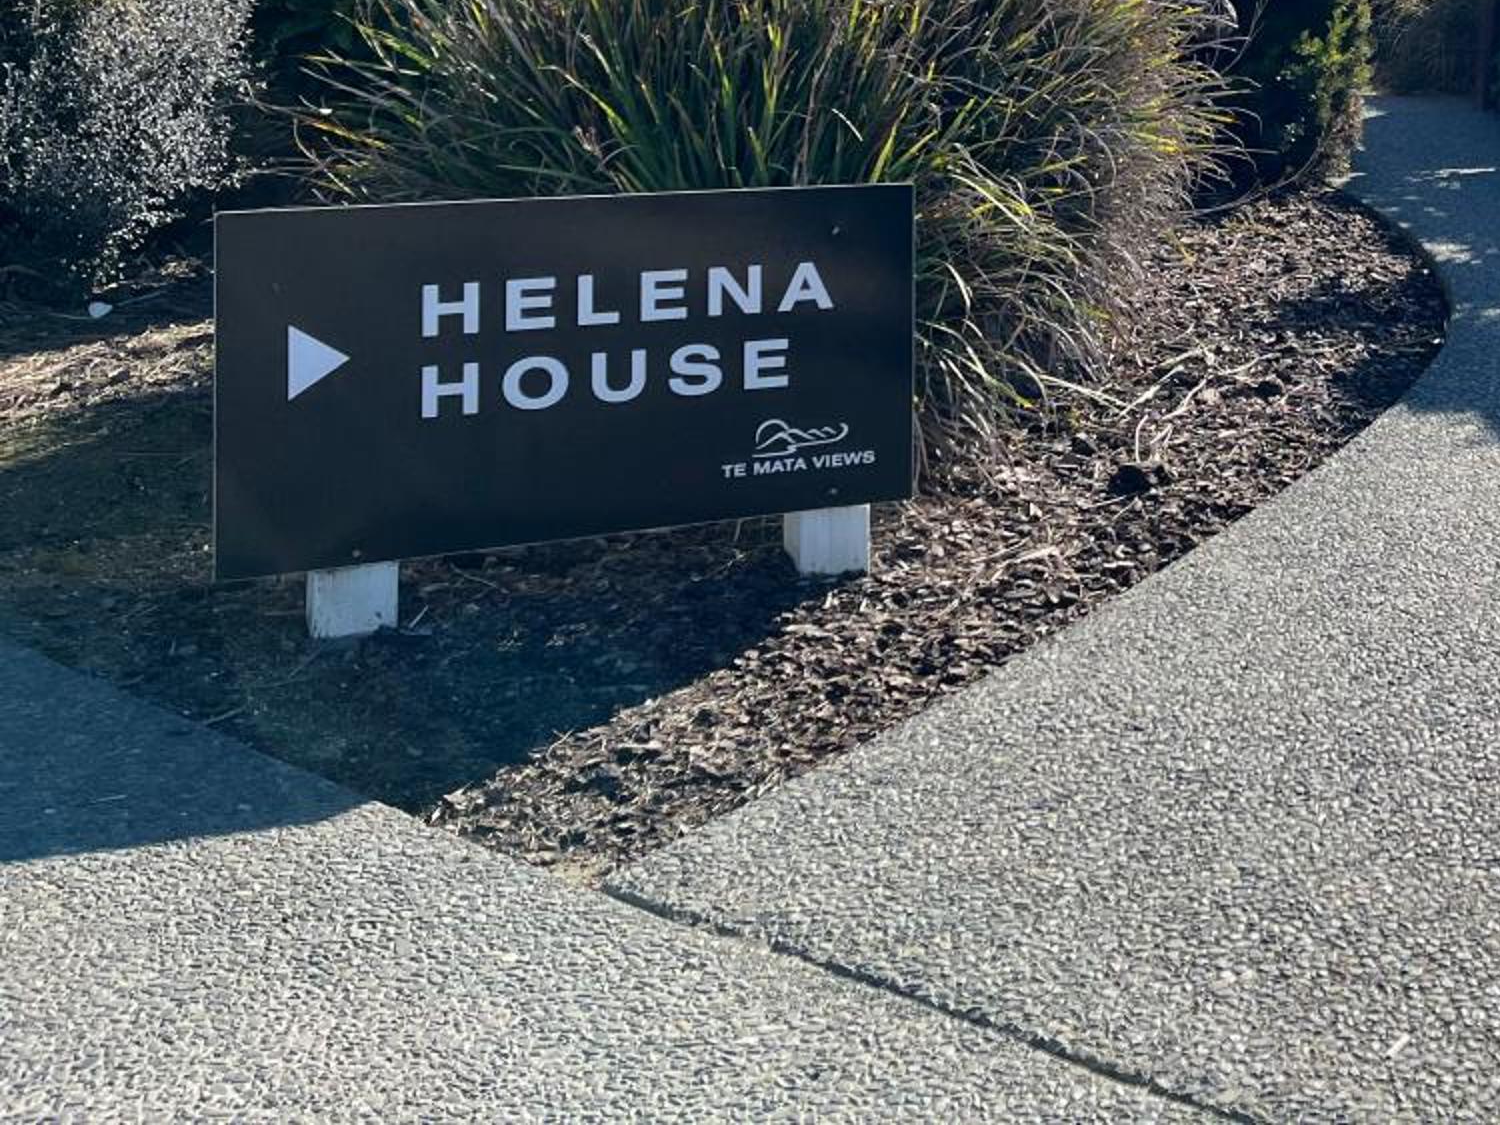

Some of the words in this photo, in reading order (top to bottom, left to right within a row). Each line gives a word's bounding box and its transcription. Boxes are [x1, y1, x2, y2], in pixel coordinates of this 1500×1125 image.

[421, 261, 834, 337] HELENA
[421, 338, 790, 418] HOUSE
[721, 463, 747, 479] TE
[753, 457, 808, 475] MATA
[812, 449, 876, 469] VIEWS
